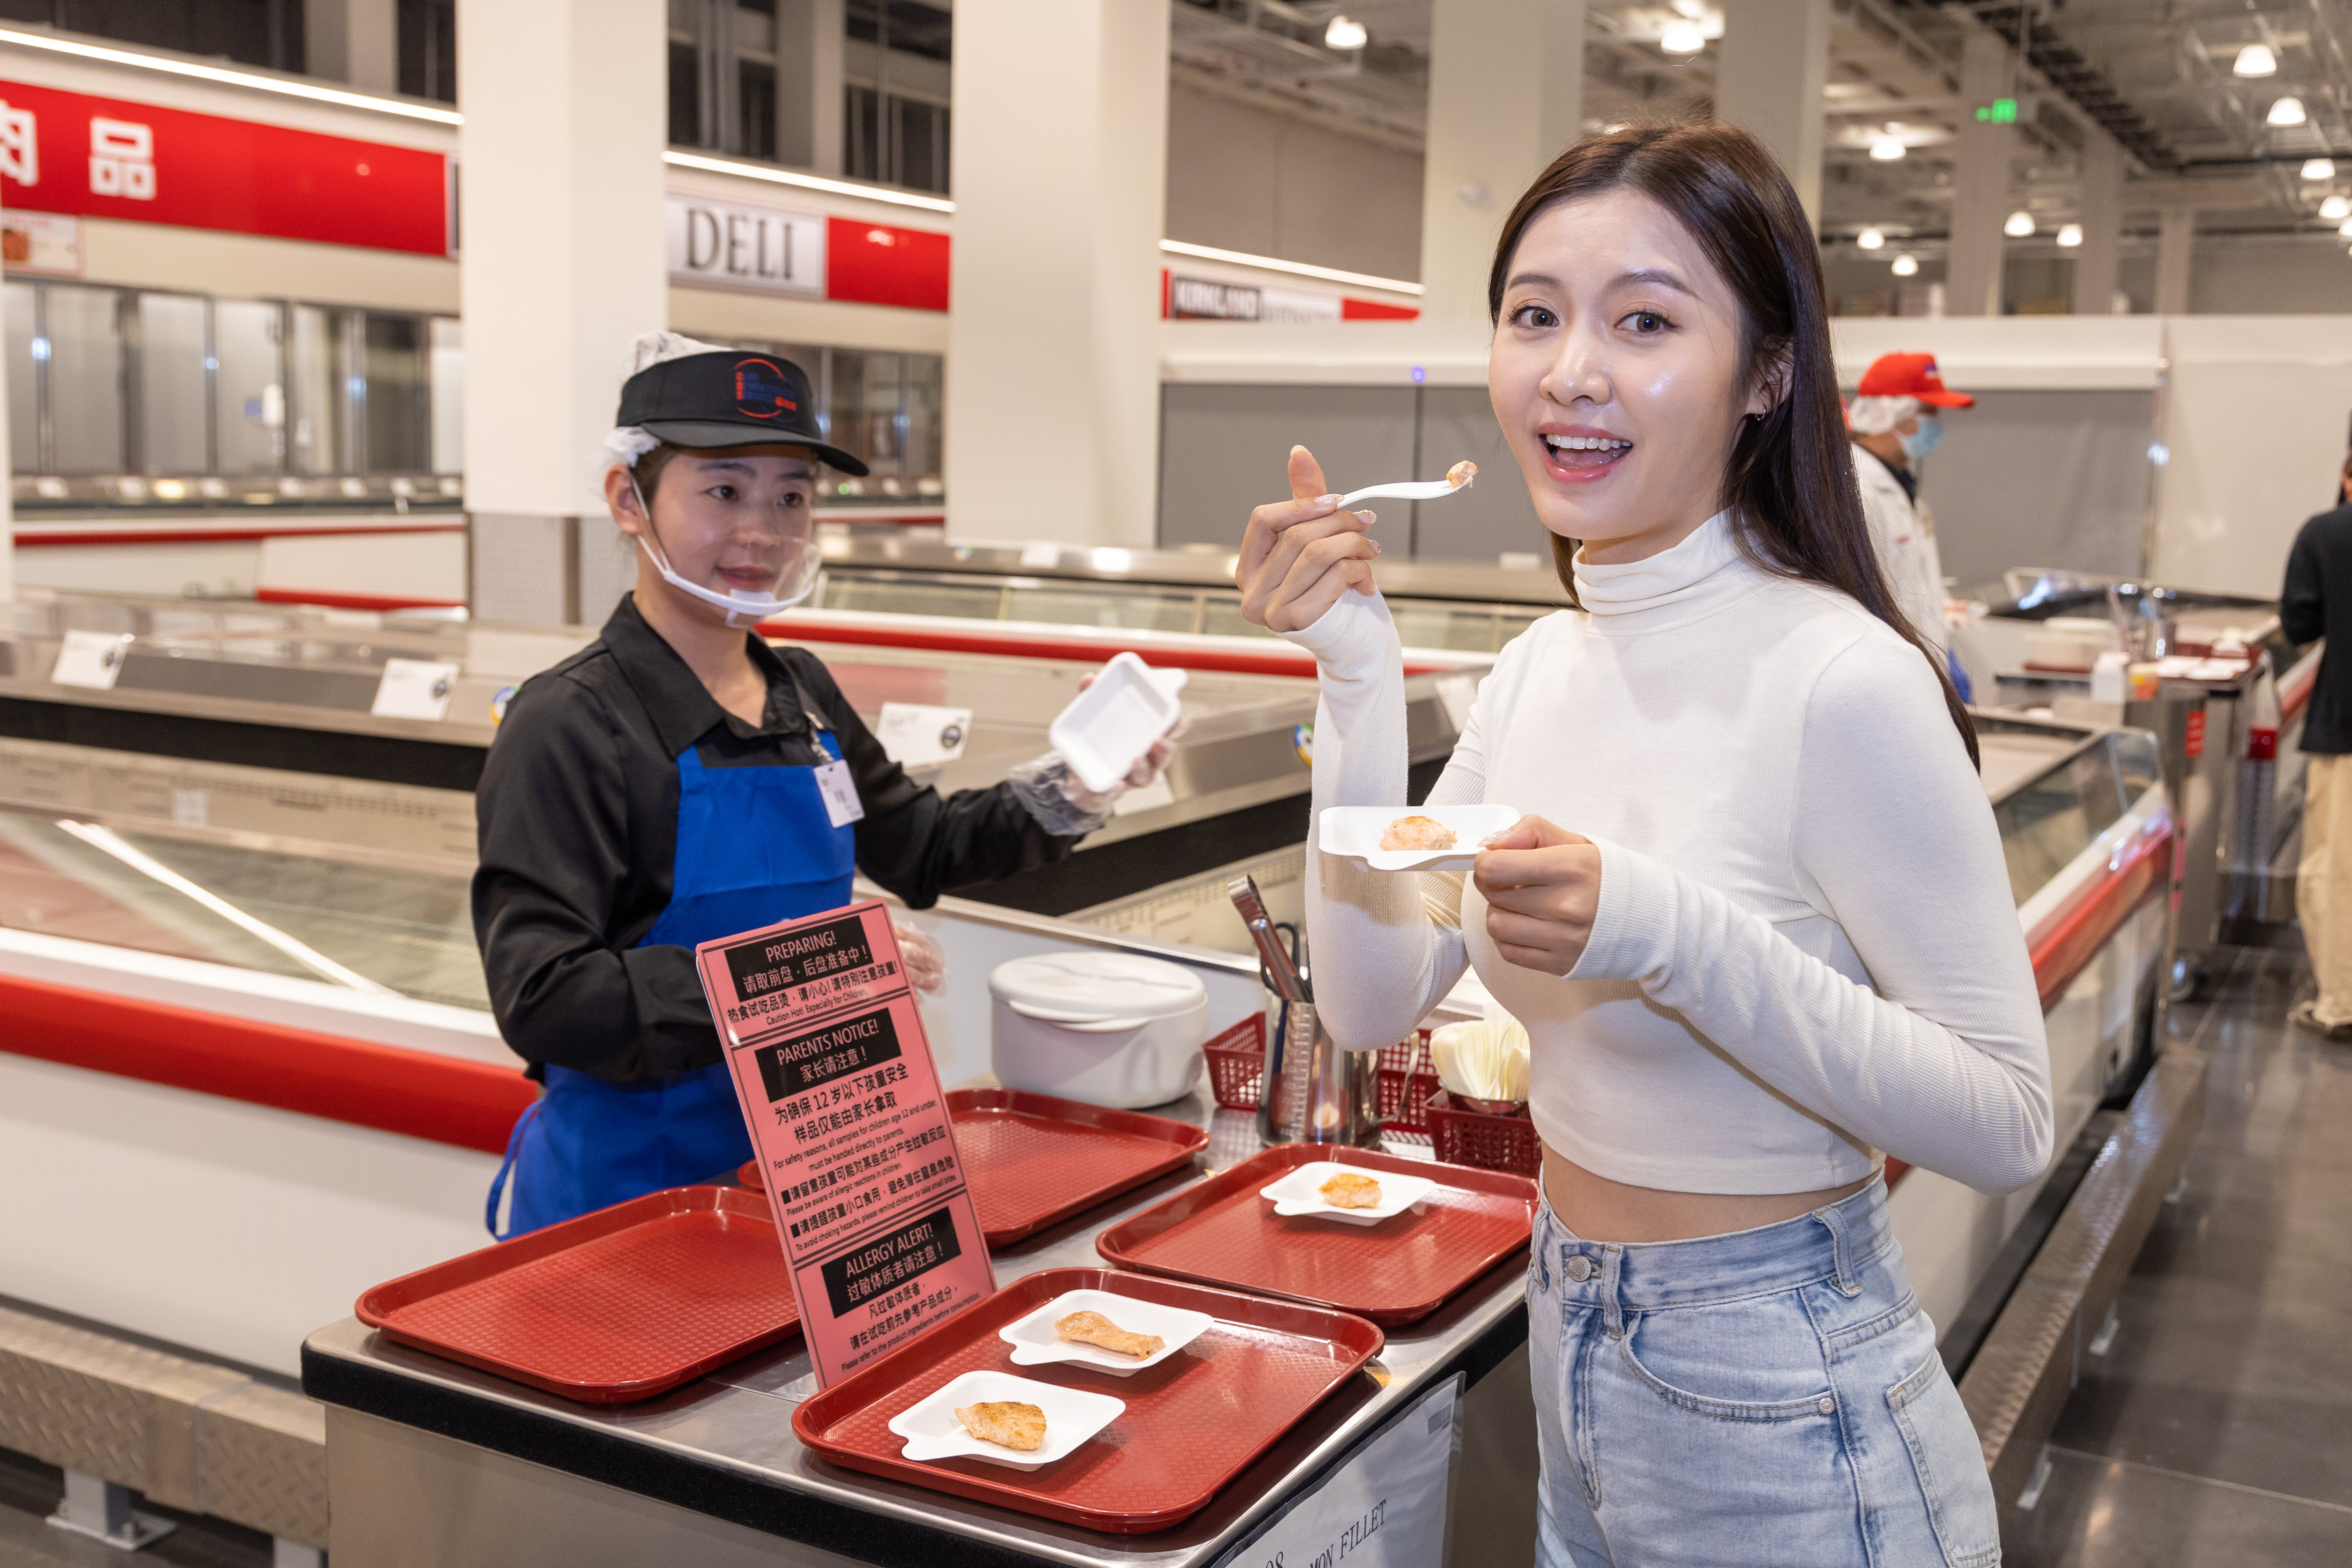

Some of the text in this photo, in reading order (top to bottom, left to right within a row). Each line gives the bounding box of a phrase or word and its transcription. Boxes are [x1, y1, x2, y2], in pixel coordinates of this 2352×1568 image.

[686, 208, 793, 281] DELI
[765, 930, 836, 962] PREPARING!
[766, 1013, 790, 1026] Caution
[790, 1007, 804, 1017] Hot!
[805, 998, 833, 1013] Especially
[833, 996, 842, 1004] for
[776, 1018, 879, 1065] PARENTS NOTICE!
[794, 1091, 897, 1144] 样品仅能由家长拿取
[813, 1092, 829, 1110] 12
[774, 1160, 784, 1169] For
[785, 1153, 803, 1166] safety
[836, 1130, 859, 1145] samples
[859, 1126, 868, 1135] for
[869, 1118, 890, 1132] children
[891, 1114, 901, 1124] age
[901, 1108, 909, 1118] 12
[909, 1105, 920, 1115] and
[809, 1159, 824, 1171] must
[832, 1146, 855, 1161] handed
[855, 1139, 875, 1153] directly
[786, 1204, 804, 1217] Please
[812, 1194, 828, 1206] aware
[828, 1189, 834, 1199] of
[834, 1183, 853, 1196] allergic
[853, 1174, 876, 1187] reactions
[804, 1236, 819, 1249] avoid
[819, 1227, 840, 1241] choking
[862, 1210, 878, 1224] please
[878, 1201, 895, 1214] remind
[895, 1193, 914, 1206] children
[920, 1186, 931, 1195] take
[931, 1178, 944, 1190] small
[847, 1223, 933, 1278] ALLERGY ALERT!
[1340, 1499, 1386, 1560] FILLET
